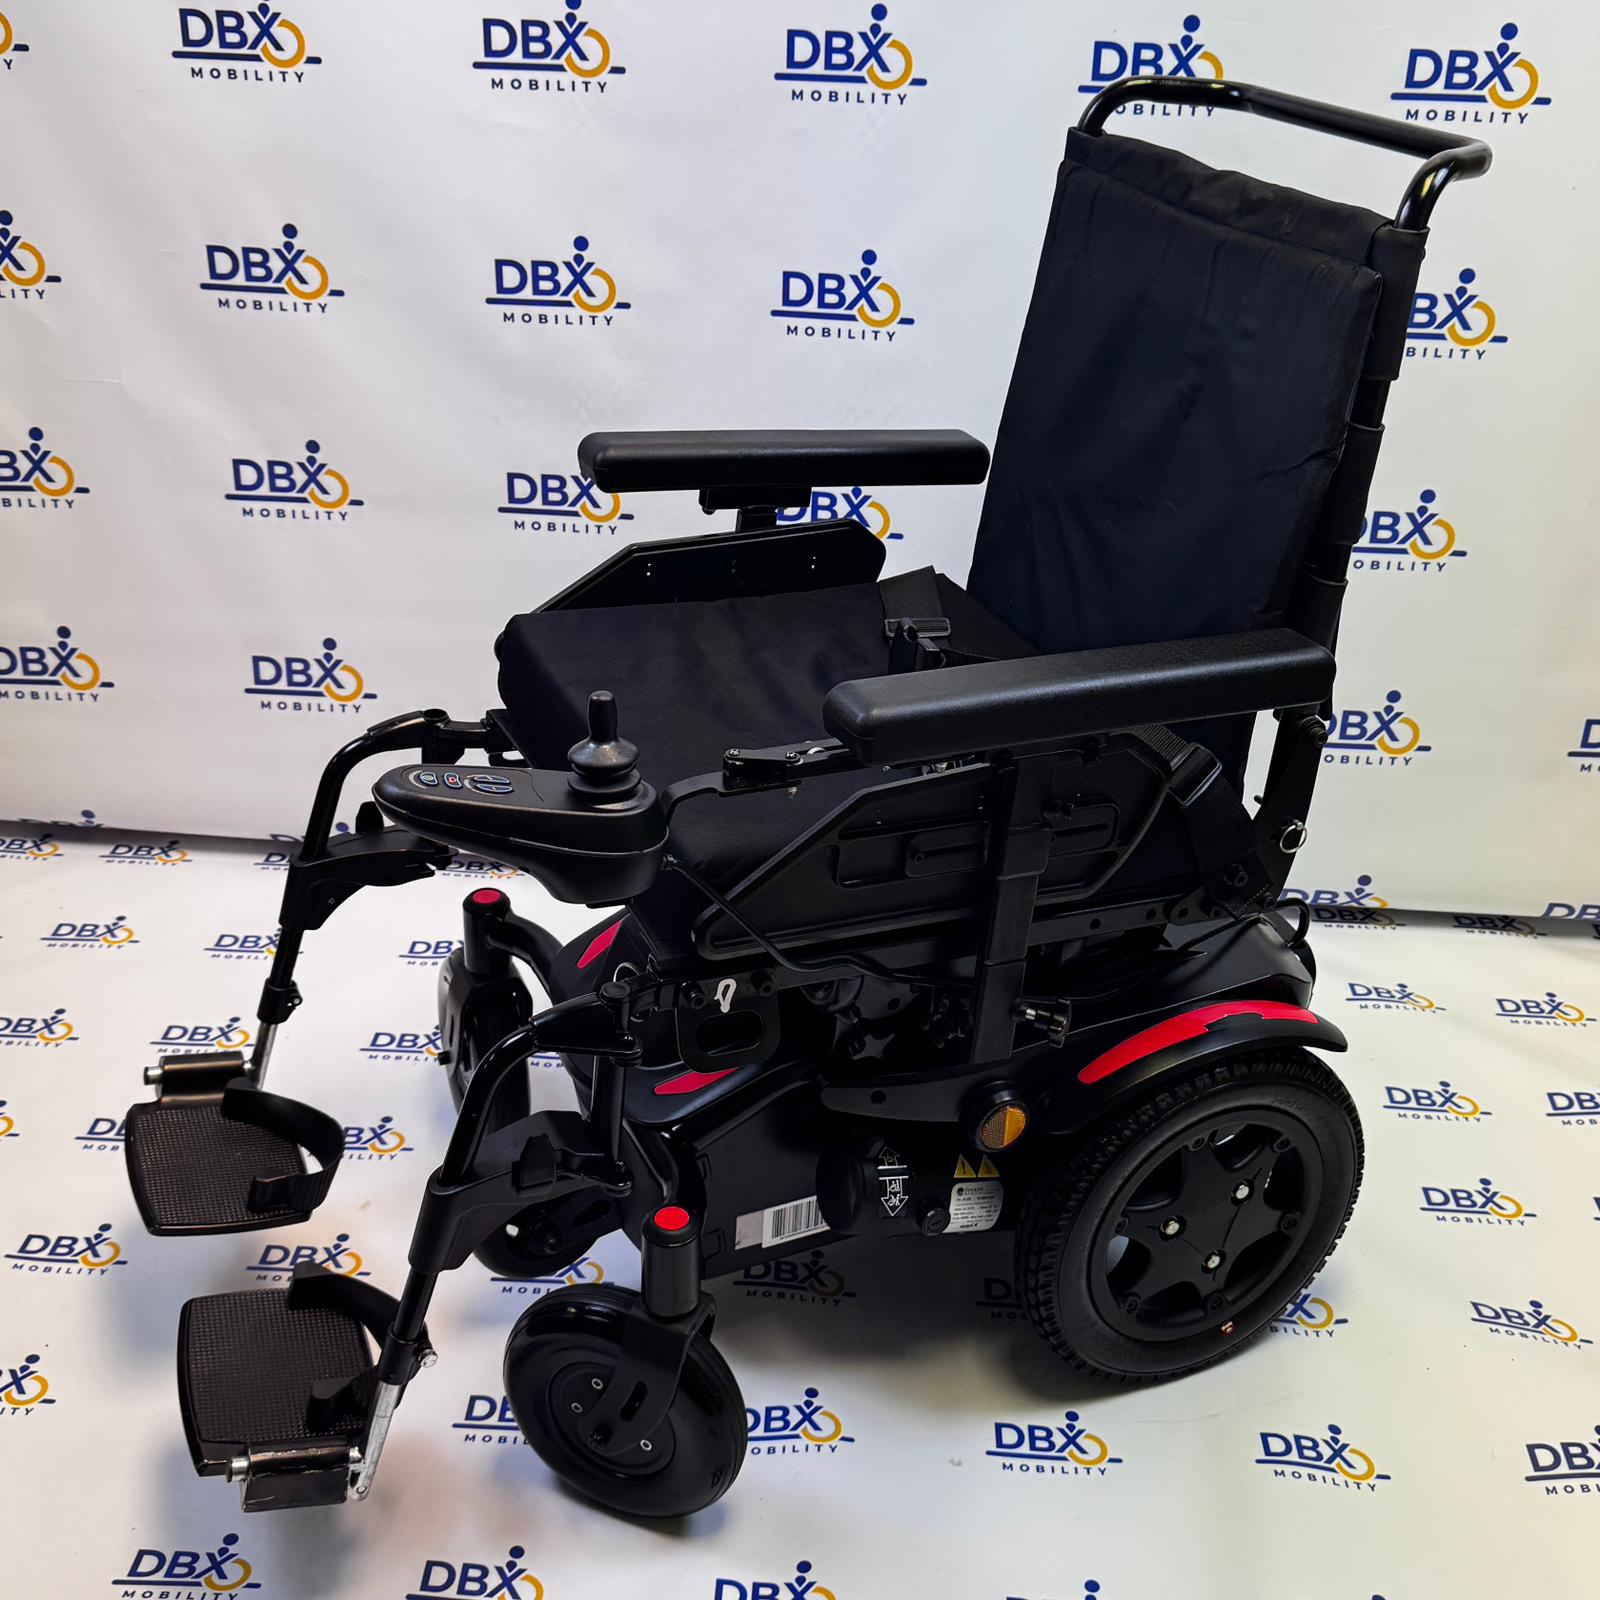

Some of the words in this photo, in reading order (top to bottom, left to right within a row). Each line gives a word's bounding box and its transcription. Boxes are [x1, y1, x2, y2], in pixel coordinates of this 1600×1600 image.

[178, 8, 286, 51] DBX
[482, 18, 589, 61] DBX
[786, 29, 892, 72] DBX
[1091, 41, 1205, 81] DBX
[190, 67, 305, 83] MOBILITY
[1404, 49, 1521, 92] DBX
[491, 78, 608, 93] MOBILITY
[791, 89, 907, 105] MOBILITY
[1115, 104, 1215, 117] OBILITY
[1405, 109, 1530, 125] MOBILITY
[206, 245, 309, 285] DBX
[494, 259, 597, 298] DBX
[782, 271, 883, 313] DBX
[218, 298, 329, 313] MOBILITY
[1408, 293, 1479, 331] BX
[503, 313, 613, 326] MOBILITY
[786, 325, 897, 342] MOBILITY
[1406, 347, 1487, 360] BILITY
[0, 450, 56, 483] BX
[232, 459, 330, 495] DBX
[507, 472, 601, 509] DBX
[2, 498, 74, 509] BILITY
[242, 508, 348, 521] MOBILITY
[514, 521, 618, 535] MOBILITY
[1361, 511, 1439, 546] BX
[1353, 560, 1447, 572] OBILITY
[252, 655, 345, 689] DBX
[0, 690, 99, 702] MOBILITY
[261, 701, 362, 714] MOBILITY
[1324, 755, 1413, 766] OBILITY
[110, 844, 178, 858] DBX
[1314, 908, 1382, 923] DBX
[1541, 902, 1600, 919] DB
[51, 923, 125, 939] DBX
[1452, 915, 1522, 931] DBX
[47, 942, 124, 950] MOBILITY
[211, 953, 269, 961] MOBILI
[1347, 982, 1421, 1004] DBX
[1359, 1003, 1436, 1014] MOBILITY
[1496, 998, 1572, 1017] DBX
[1509, 1018, 1588, 1029] MOBILITY
[160, 1024, 240, 1042] DBX
[369, 1032, 442, 1050] DBX
[5, 1040, 63, 1048] BILITY
[368, 1054, 439, 1062] MOBILIT
[1385, 1086, 1465, 1110] DBX
[1546, 1091, 1600, 1112] DB
[1397, 1112, 1482, 1123] MOBILITY
[344, 1127, 394, 1145] BX
[1420, 1186, 1508, 1211] DBX
[1435, 1215, 1526, 1227] MOBILITY
[17, 1234, 113, 1258] DBX
[12, 1263, 109, 1276] MOBILITY
[746, 1289, 842, 1307] MOBILITY
[1470, 1300, 1563, 1334] DBX
[1269, 1325, 1335, 1338] BILITY
[1489, 1326, 1583, 1350] MOBILITY
[994, 1422, 1089, 1455] DBX
[751, 1443, 838, 1455] OBILITY
[1259, 1431, 1358, 1471] DBX
[1002, 1461, 1107, 1476] MOBILITY
[1273, 1468, 1377, 1492] MOBILITY
[127, 1549, 239, 1580] DBX
[419, 1560, 528, 1600] DBX
[122, 1590, 239, 1600] MOBILITY
